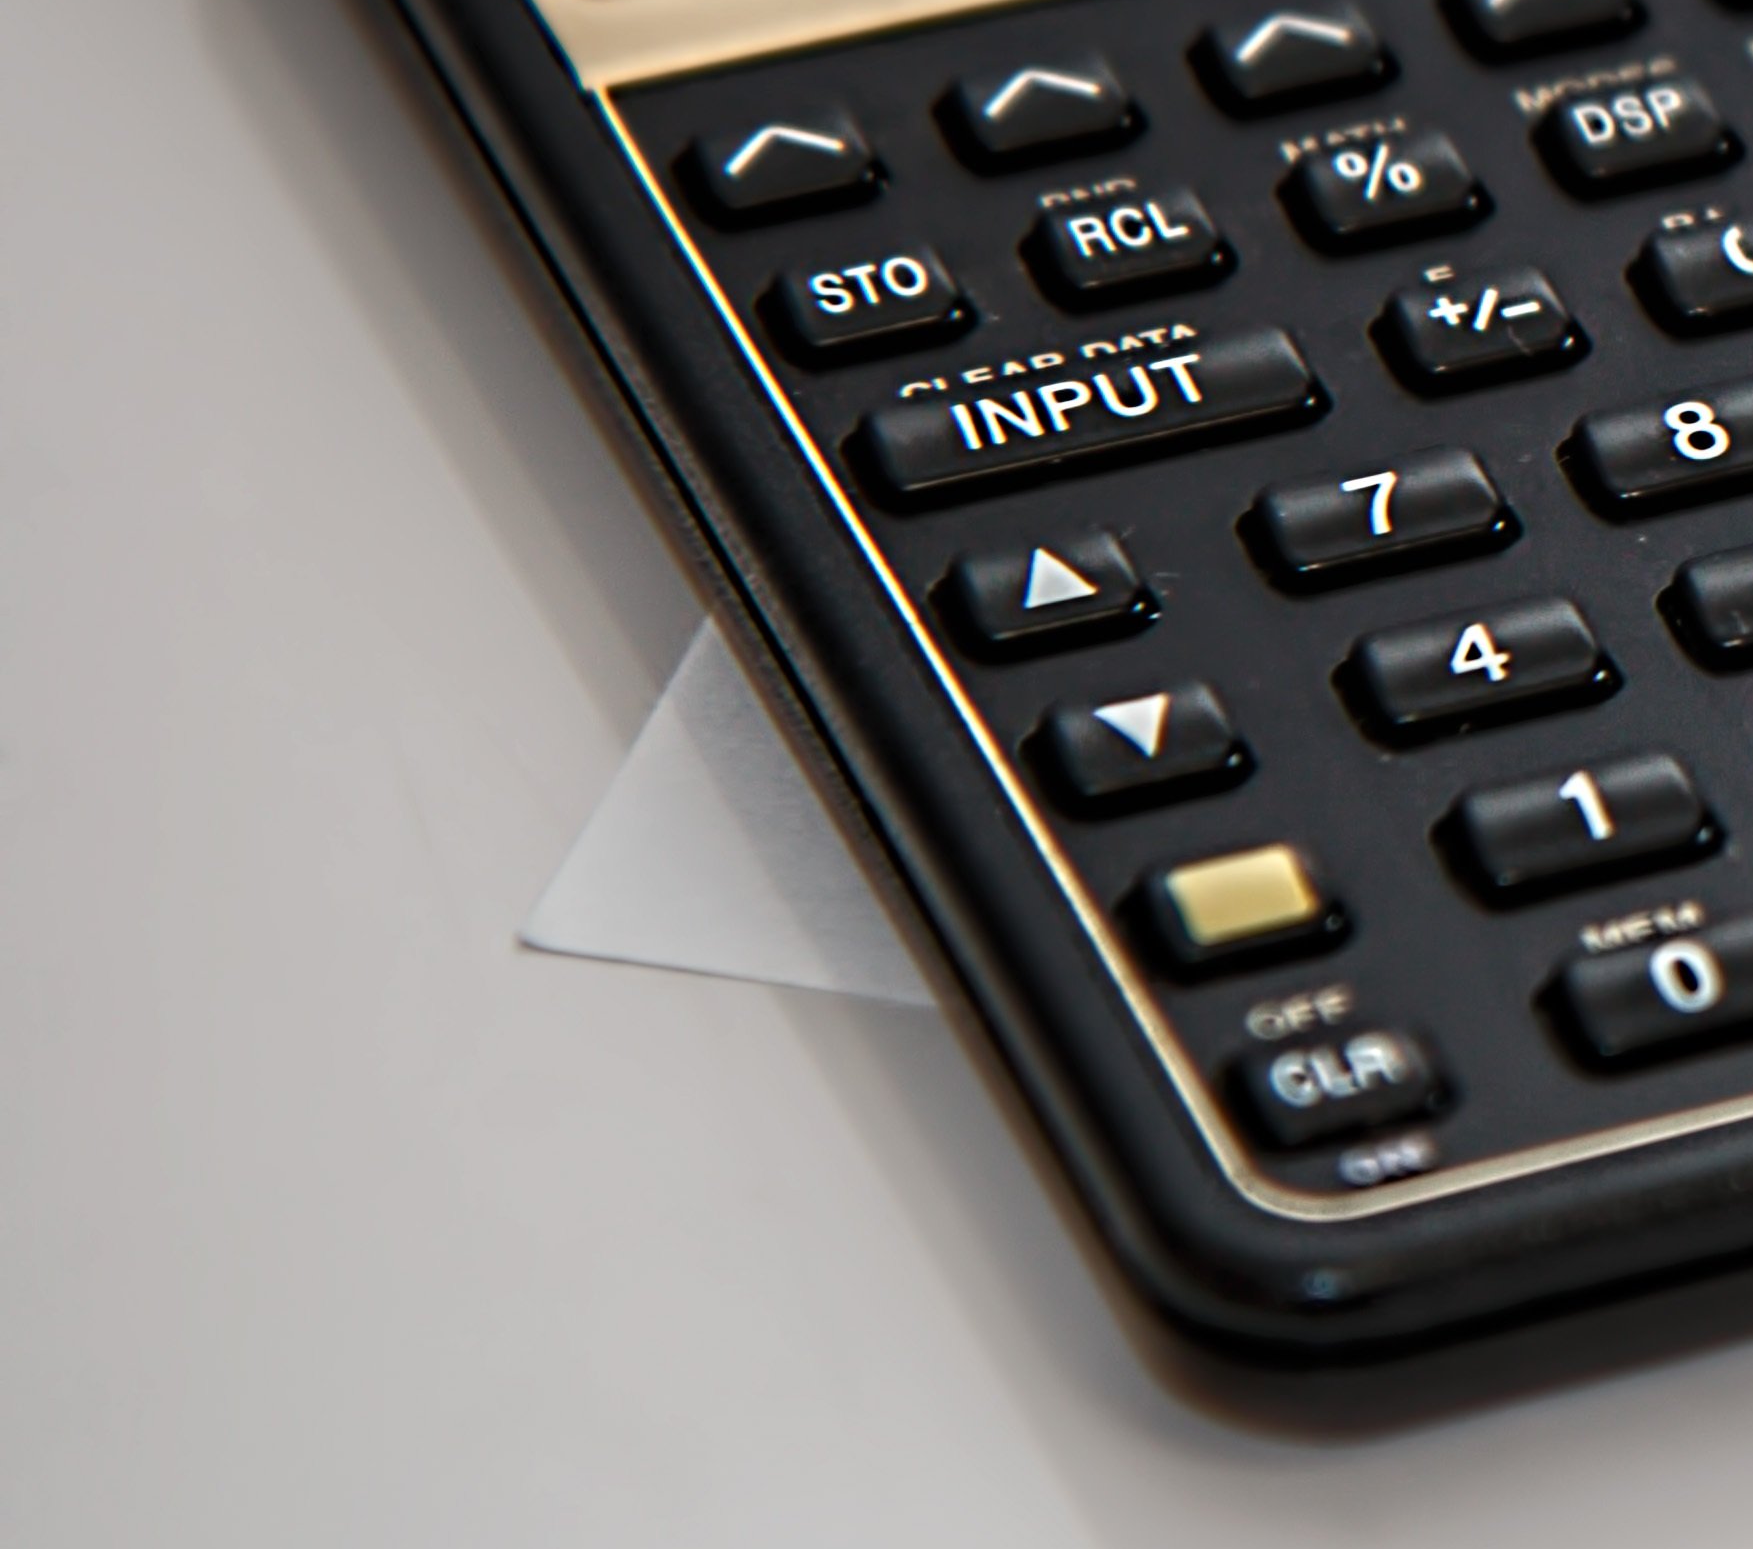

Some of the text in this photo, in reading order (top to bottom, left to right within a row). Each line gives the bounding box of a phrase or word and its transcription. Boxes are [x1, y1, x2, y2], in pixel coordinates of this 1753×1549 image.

[1572, 87, 1681, 144] DSP
[1332, 143, 1422, 200] %
[1067, 202, 1189, 257] RCL
[809, 255, 928, 315] STO
[950, 352, 1202, 450] INPUT
[1664, 401, 1730, 460] 8
[1341, 471, 1398, 537] 7
[1449, 623, 1509, 682] 4
[1560, 770, 1614, 842] 1
[1580, 899, 1703, 951] MEM
[1650, 940, 1725, 1012] 0
[1246, 983, 1354, 1041] OFF
[1271, 1033, 1403, 1106] CLR
